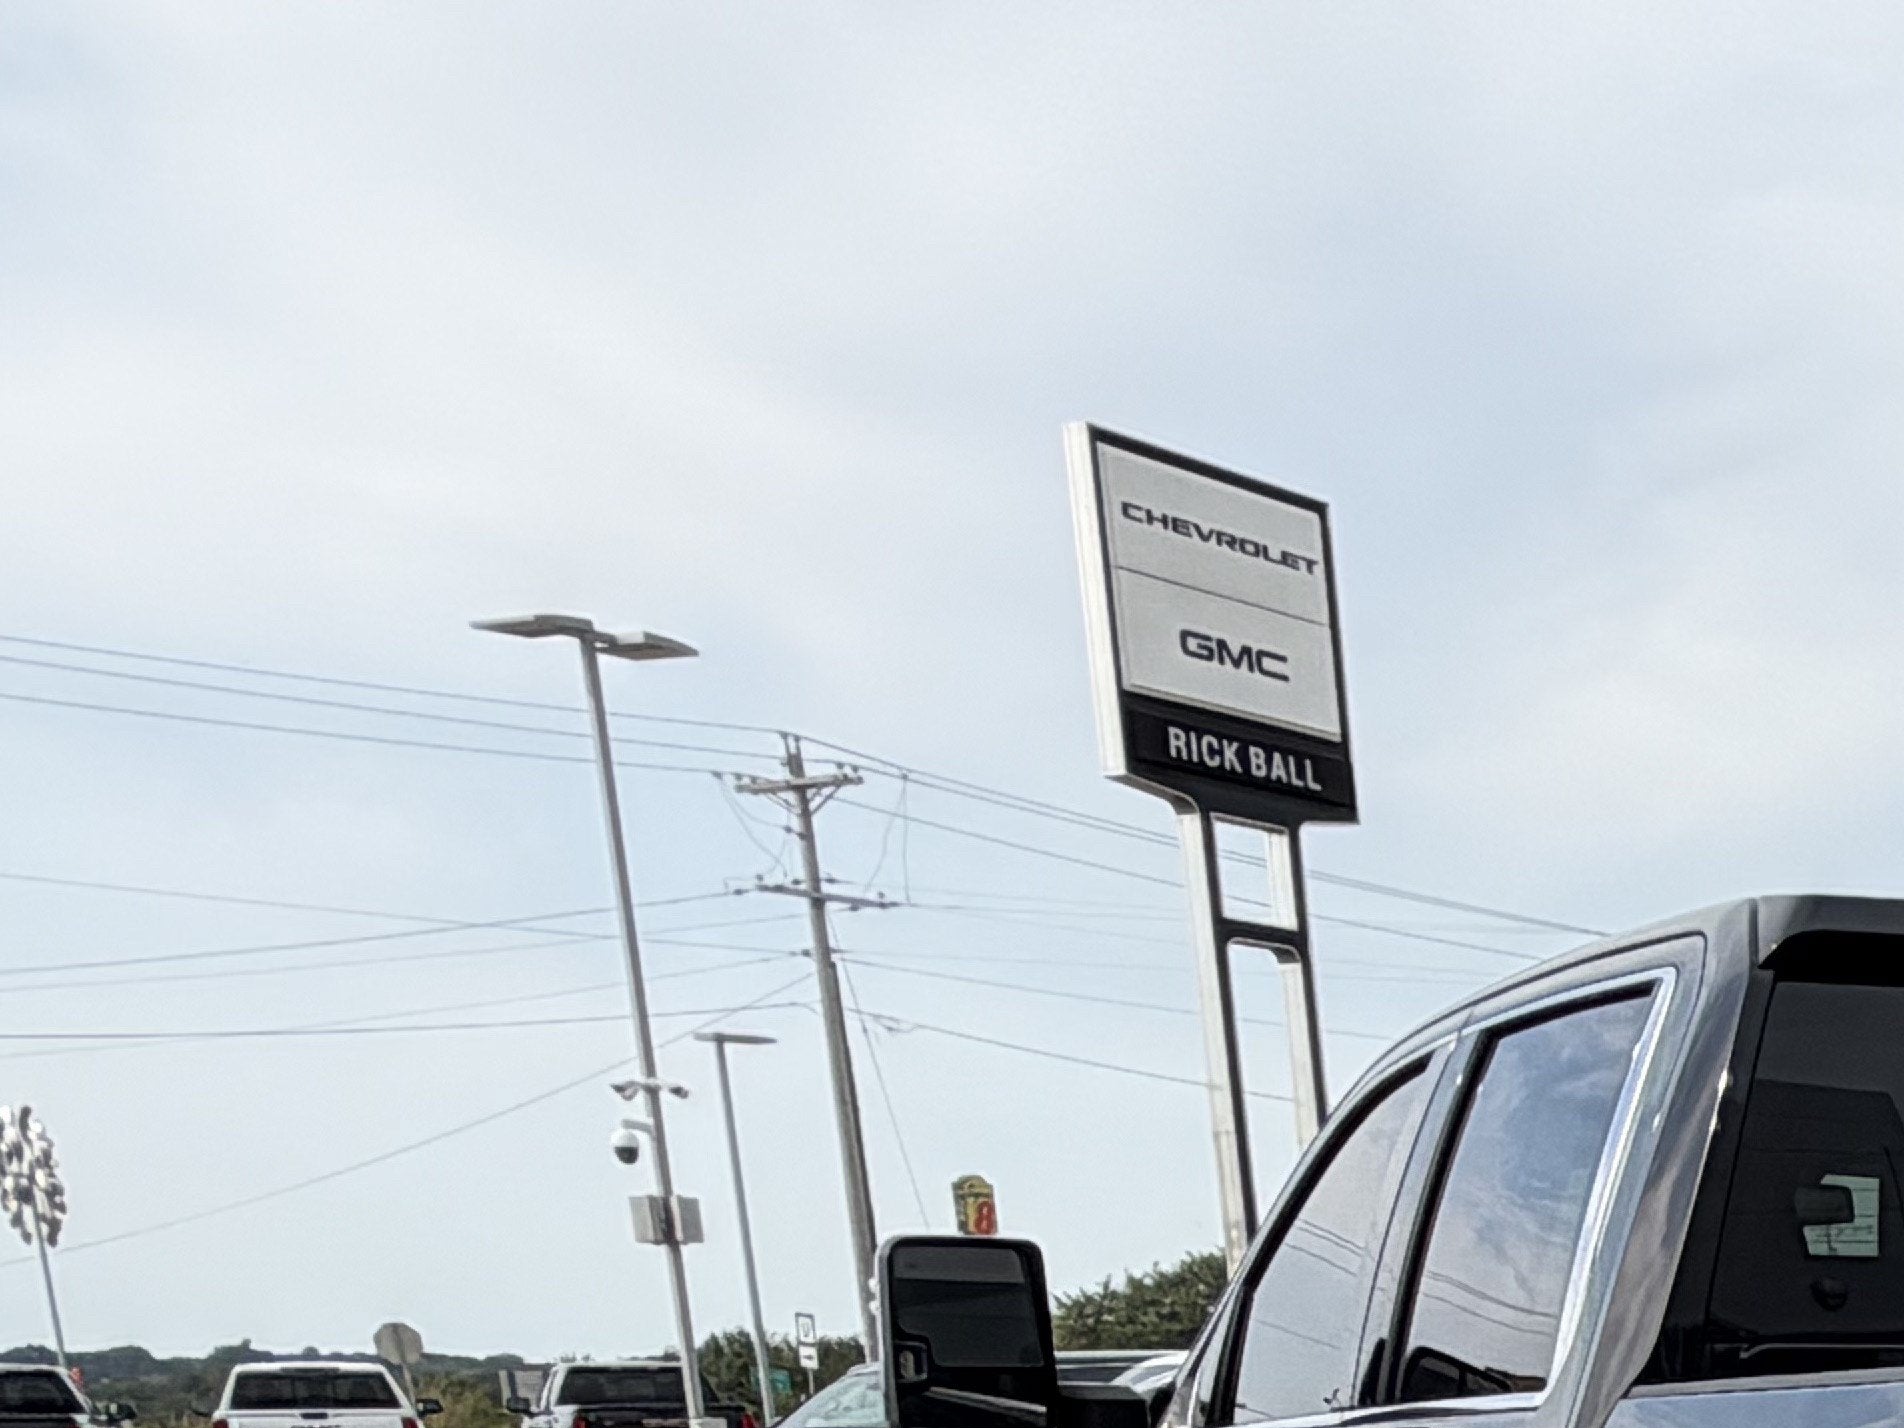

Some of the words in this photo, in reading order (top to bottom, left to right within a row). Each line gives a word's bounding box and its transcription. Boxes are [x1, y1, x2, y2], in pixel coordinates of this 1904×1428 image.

[1121, 501, 1319, 575] CHEVROLET
[1179, 628, 1290, 682] GMC
[1167, 726, 1243, 774] RICK
[1248, 746, 1322, 791] BALL
